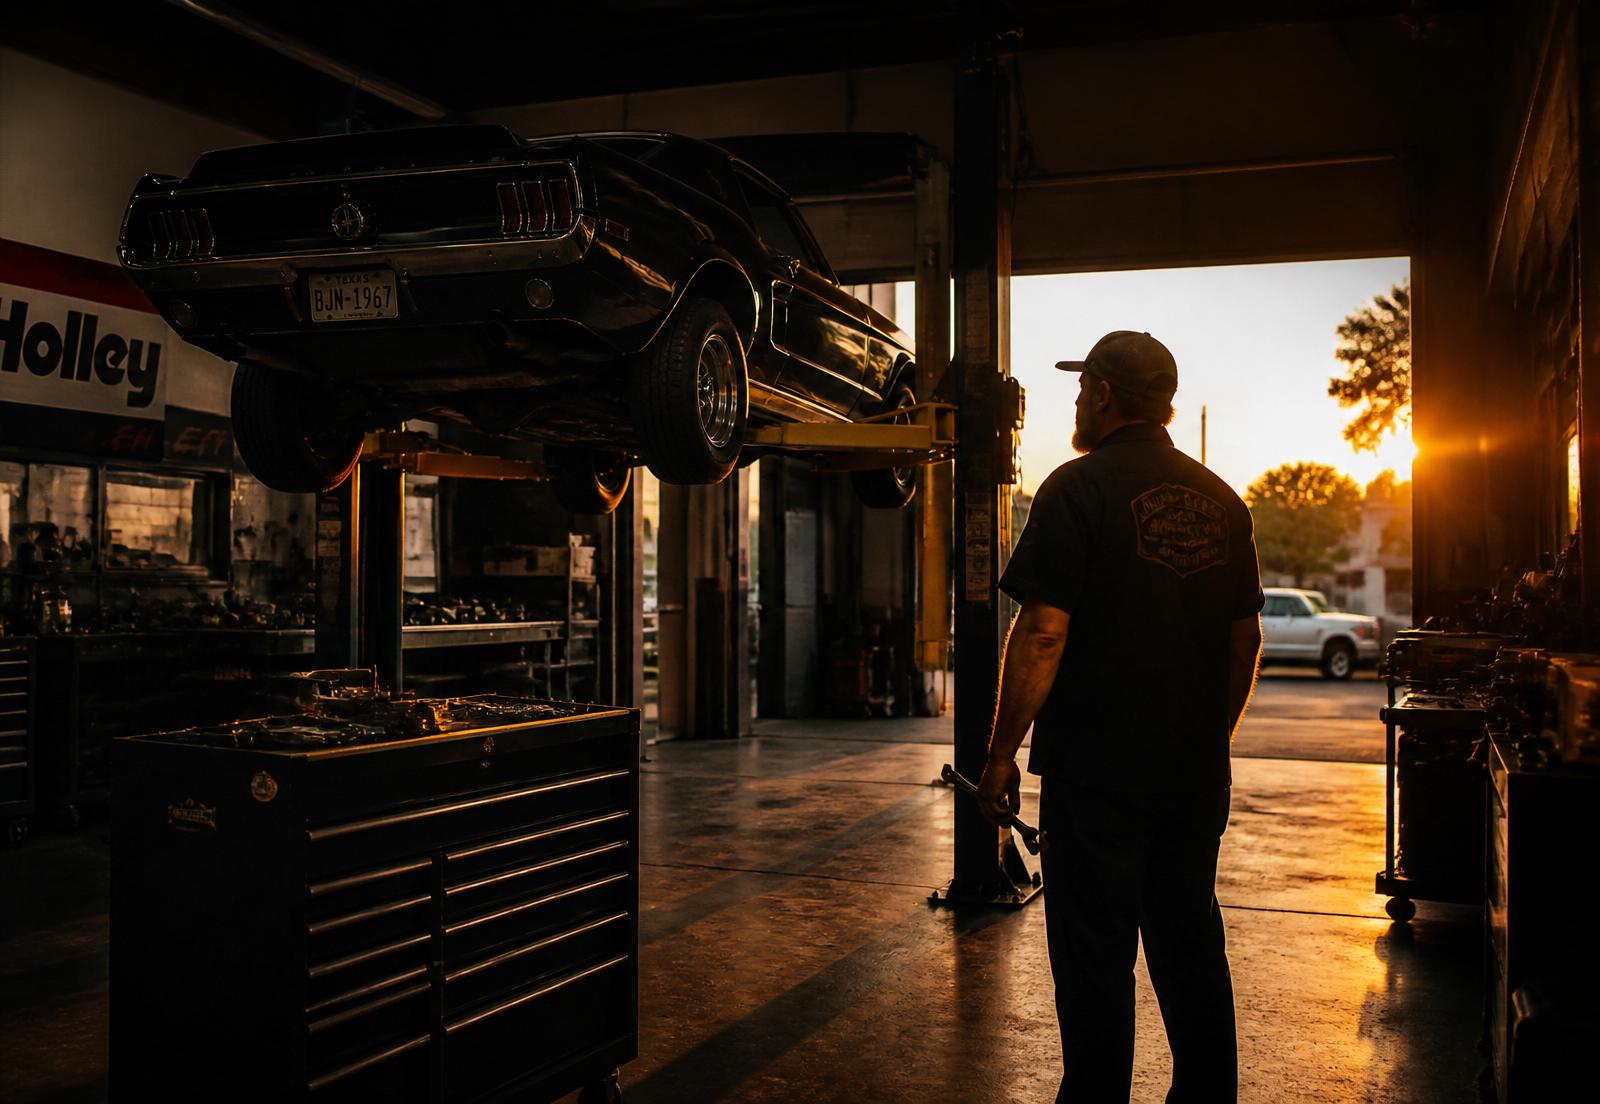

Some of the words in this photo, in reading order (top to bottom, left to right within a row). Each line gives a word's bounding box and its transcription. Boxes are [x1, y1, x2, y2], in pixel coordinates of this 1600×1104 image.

[336, 274, 369, 285] TEXAS
[314, 285, 392, 312] BJN-1967
[0, 297, 161, 408] Holley
